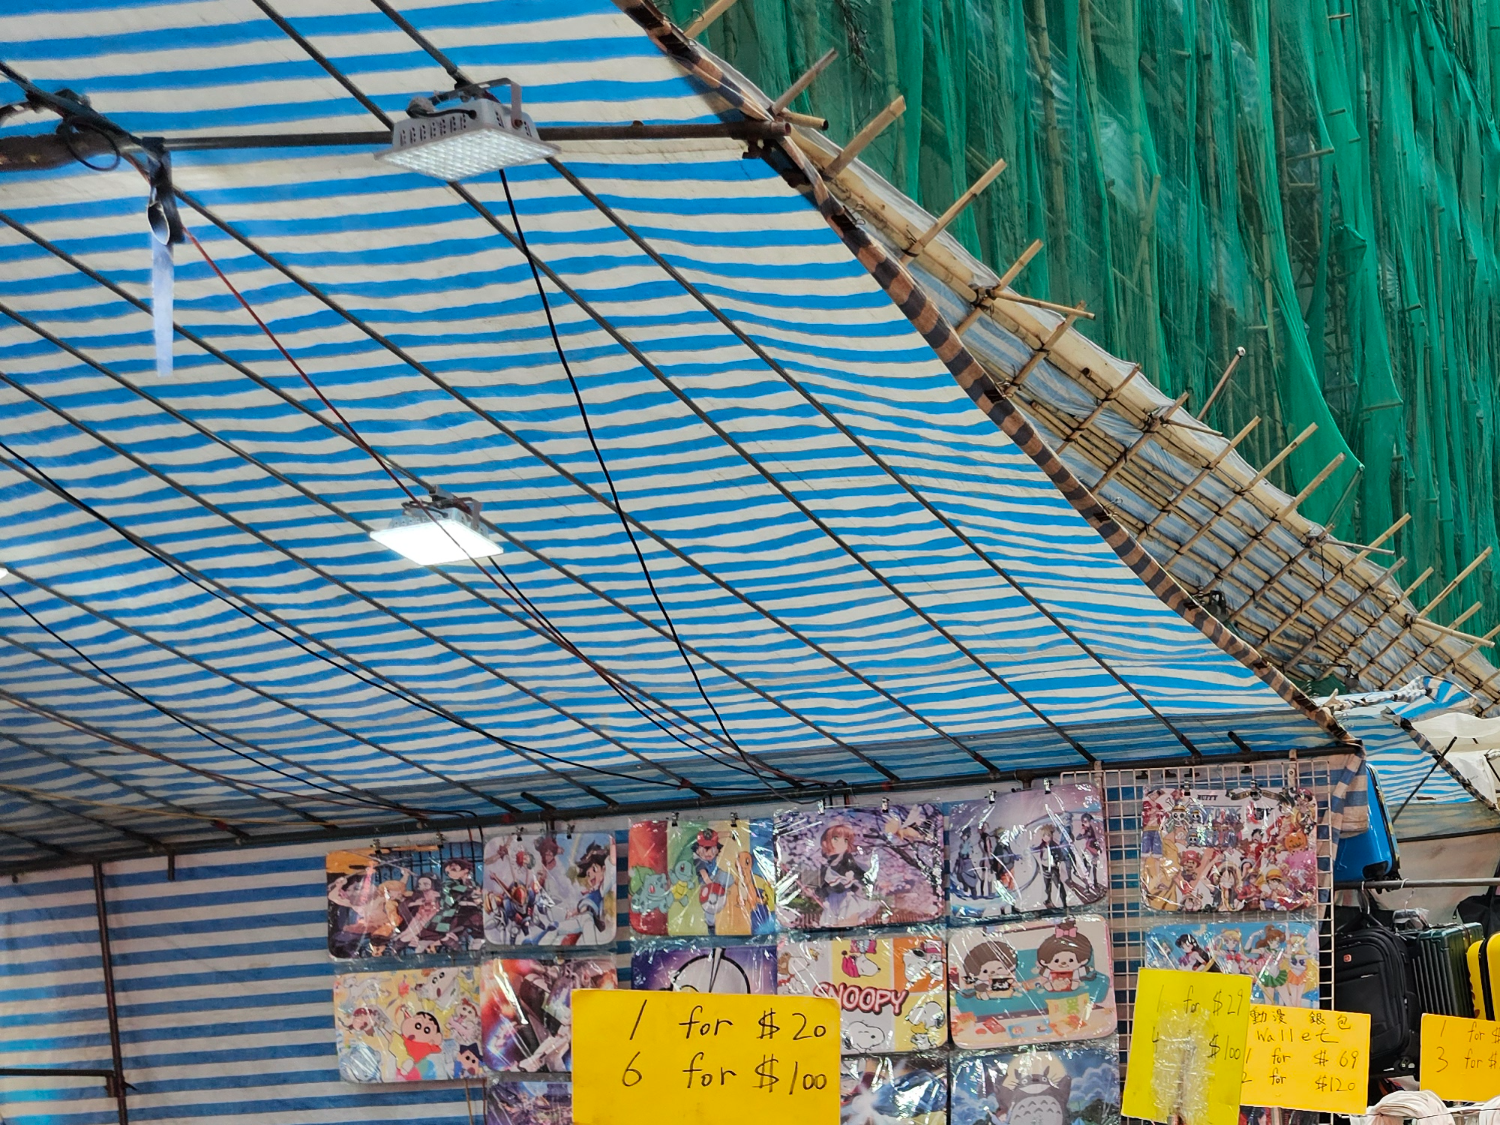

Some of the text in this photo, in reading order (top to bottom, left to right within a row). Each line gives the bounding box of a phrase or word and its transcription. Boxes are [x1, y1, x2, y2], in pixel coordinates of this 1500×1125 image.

[813, 981, 909, 1016] SNOOPY
[1157, 985, 1164, 1012] 1
[1183, 985, 1200, 1014] for
[630, 999, 647, 1040] 1
[679, 1005, 733, 1039] for
[1440, 1020, 1447, 1037] 1
[1468, 1023, 1485, 1043] for
[1207, 1034, 1241, 1061] $100
[1257, 1027, 1339, 1043] Wallet
[1245, 1048, 1252, 1063] 1
[1271, 1047, 1291, 1064] for
[1436, 1047, 1449, 1072] 3
[1464, 1048, 1483, 1070] for
[622, 1051, 827, 1095] 6 for $100
[1269, 1067, 1287, 1085] for
[1315, 1075, 1356, 1092] $120
